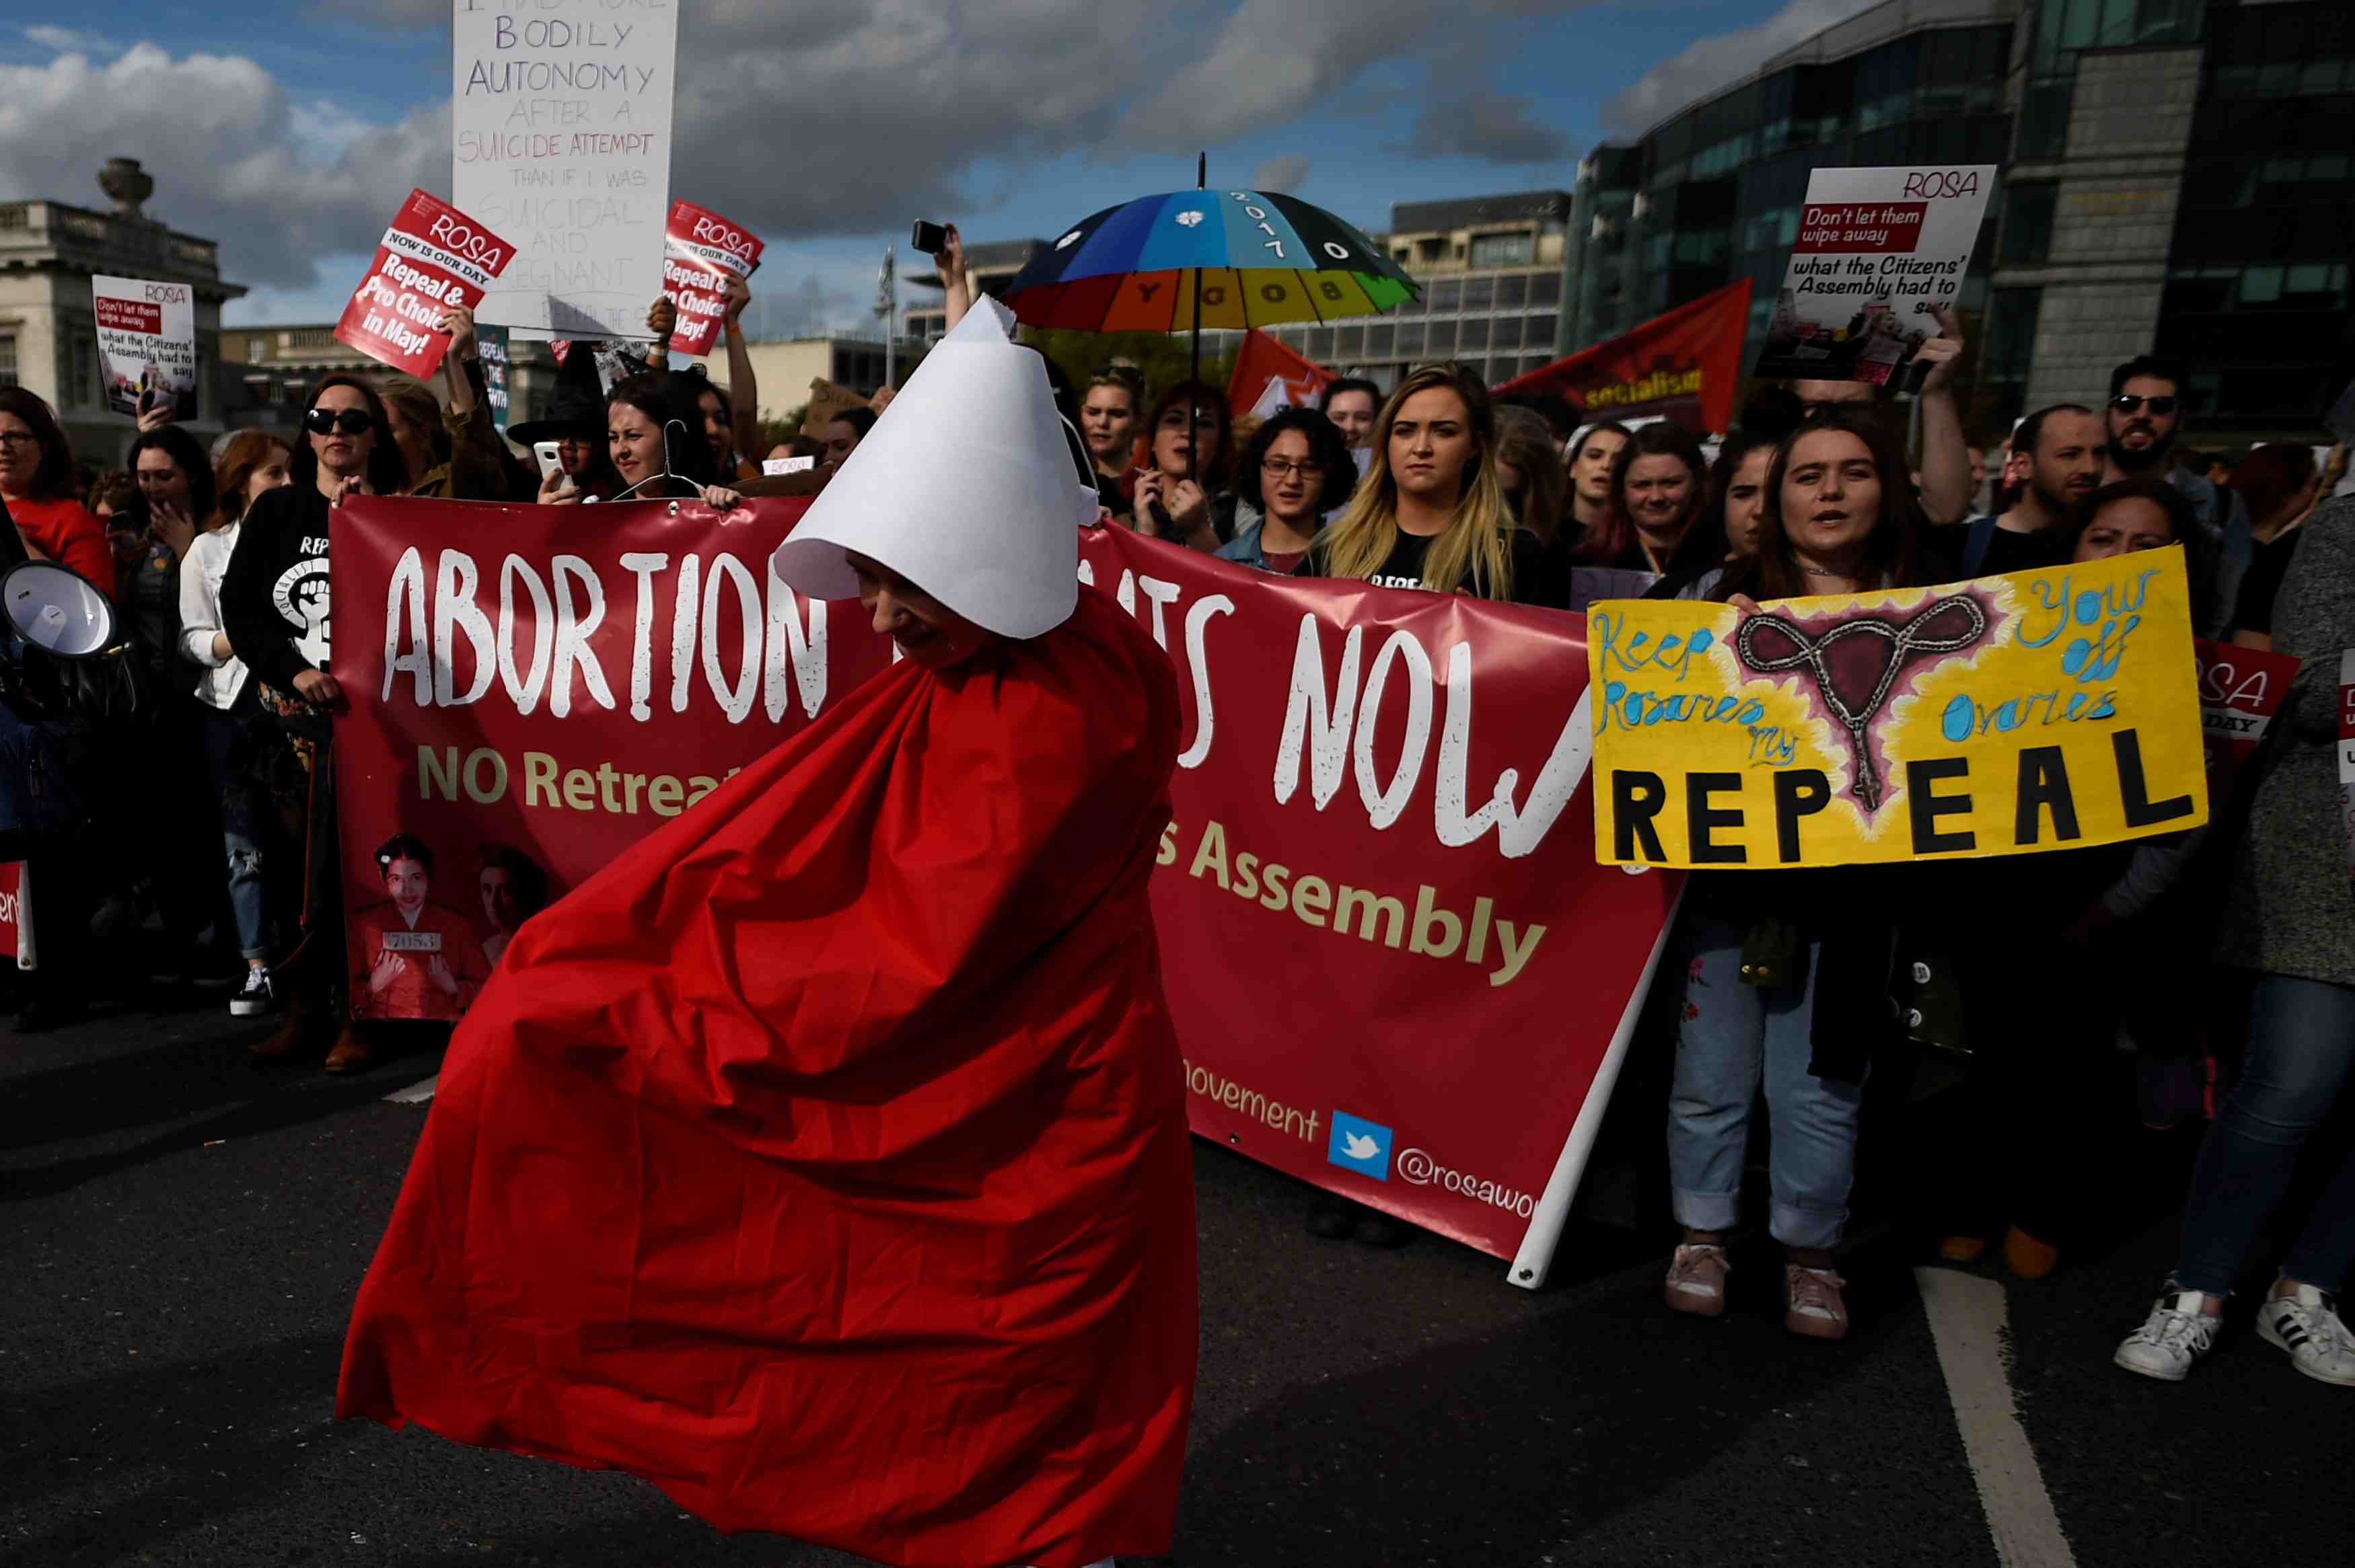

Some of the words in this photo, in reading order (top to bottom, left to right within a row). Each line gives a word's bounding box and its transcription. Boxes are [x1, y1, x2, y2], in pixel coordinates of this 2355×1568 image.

[495, 15, 633, 48] BODILY
[466, 60, 655, 96] AUTONOMY
[506, 99, 590, 126] AFTER
[614, 100, 630, 122] A
[458, 130, 563, 161] SUICIDE
[569, 134, 655, 157] ATTEMPT
[509, 168, 554, 186] THAN
[561, 169, 577, 186] IF
[605, 170, 648, 188] WAS
[1904, 171, 1979, 199] ROSA
[478, 193, 644, 229] SUICIDAL
[1806, 207, 1853, 226] Don't
[1856, 207, 1877, 225] let
[1881, 207, 1920, 224] them
[430, 215, 502, 270] ROSA
[532, 233, 588, 254] AND
[692, 217, 754, 260] ROSA
[1803, 227, 1840, 247] wipe
[1843, 229, 1889, 246] away
[388, 233, 421, 251] NOW
[421, 245, 433, 257] IS
[434, 252, 461, 270] OUR
[462, 268, 490, 286] DAY
[699, 246, 723, 261] OUR
[724, 255, 748, 271] DAY
[1793, 256, 1841, 276] what
[1847, 256, 1875, 275] the
[1879, 255, 1968, 276] Citizens'
[381, 252, 450, 301] Repeal
[443, 287, 464, 306] &
[663, 258, 716, 292] Repeal
[1797, 277, 1892, 300] Assembly
[1895, 276, 1934, 295] had
[1937, 278, 1956, 295] to
[98, 298, 122, 312] Don't
[123, 302, 135, 315] let
[137, 303, 159, 318] them
[145, 285, 185, 303] ROSA
[363, 275, 396, 307] Pro
[396, 292, 443, 332] Choic
[678, 289, 725, 318] Choice
[98, 311, 120, 326] wipe
[120, 315, 145, 329] away
[361, 307, 384, 335] in
[382, 317, 431, 356] May!
[100, 331, 124, 344] what
[128, 334, 143, 347] the
[107, 343, 157, 365] Assembly
[157, 352, 179, 364] had
[181, 353, 192, 365] to
[172, 367, 193, 379] say
[300, 536, 330, 555] REP
[2017, 568, 2163, 648] Your
[382, 546, 828, 724] ABORTION
[1593, 613, 1714, 681] Keep
[1274, 613, 1593, 859] NOW
[2206, 714, 2258, 733] DAY
[418, 744, 508, 805] NO
[523, 752, 741, 817] Retrea
[1611, 729, 2195, 864] REPEAL
[1188, 819, 1548, 987] Assembly
[1396, 1147, 1541, 1219] @rosawo
